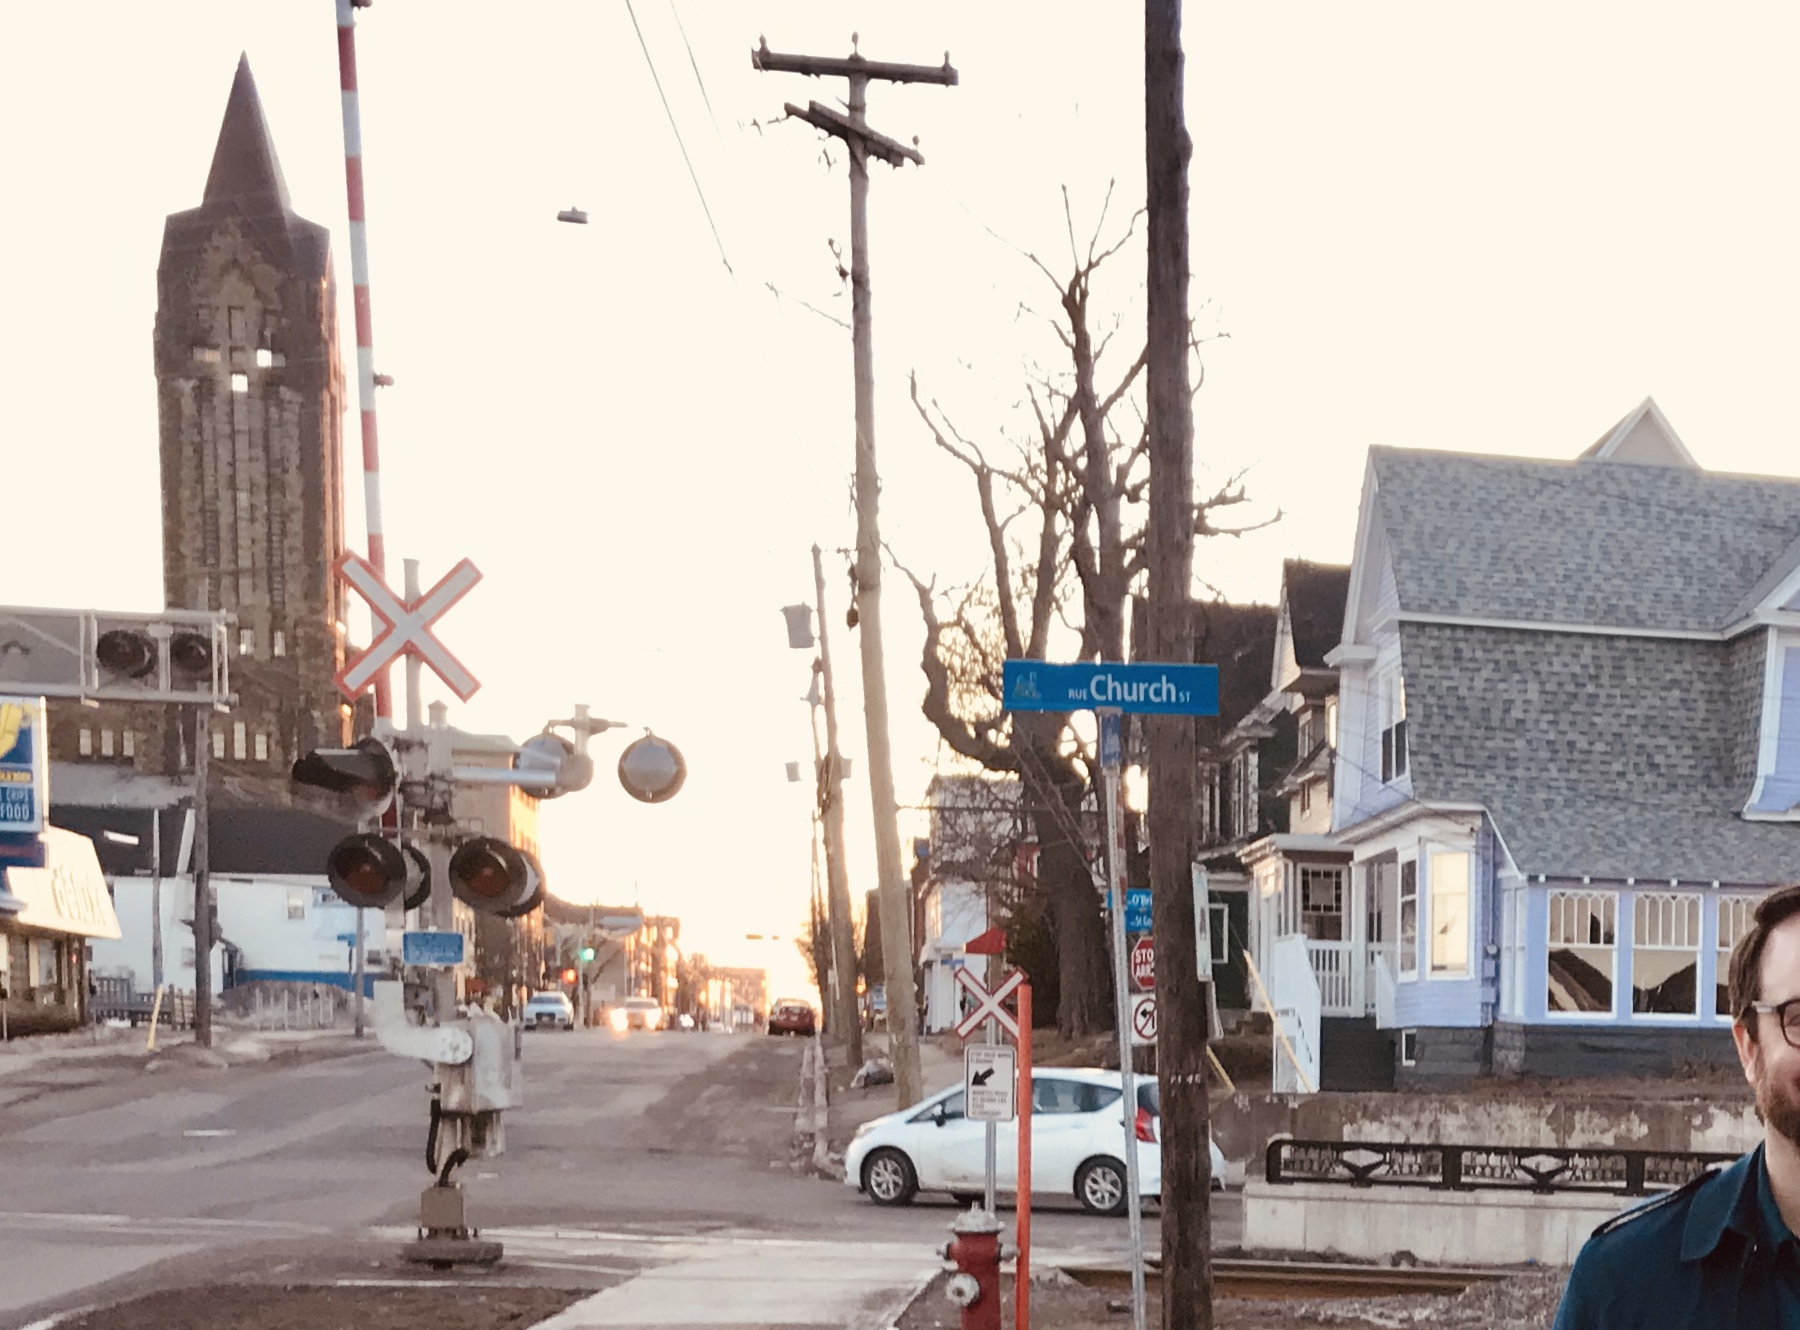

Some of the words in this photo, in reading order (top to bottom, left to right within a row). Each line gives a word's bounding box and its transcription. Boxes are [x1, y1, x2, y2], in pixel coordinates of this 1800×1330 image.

[1068, 688, 1088, 700] RUE
[1090, 673, 1177, 703] Church
[1179, 690, 1191, 703] ST
[1135, 948, 1154, 963] STO
